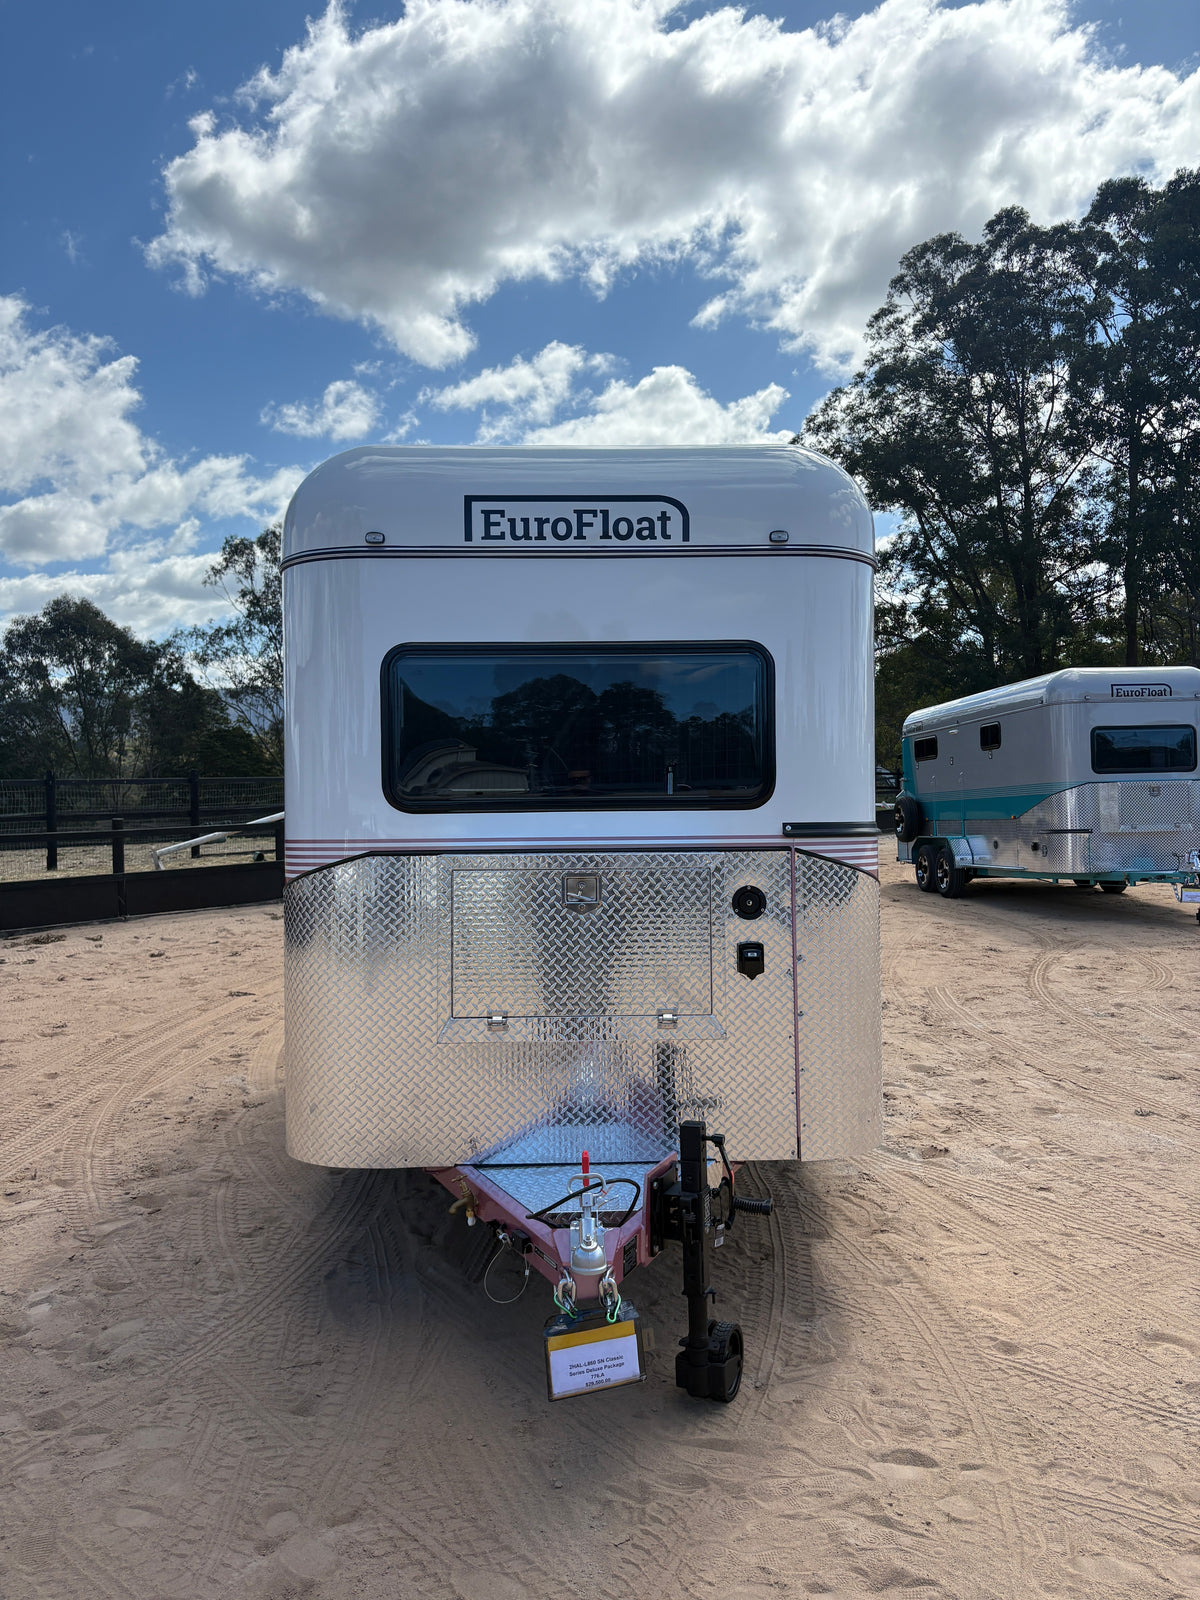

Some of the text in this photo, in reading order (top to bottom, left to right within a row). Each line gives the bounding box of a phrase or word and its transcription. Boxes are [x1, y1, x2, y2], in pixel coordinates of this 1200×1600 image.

[480, 508, 672, 541] EuroFloat
[1115, 688, 1168, 698] EuroFloat
[605, 1354, 624, 1362] Classic
[604, 1361, 625, 1369] Package
